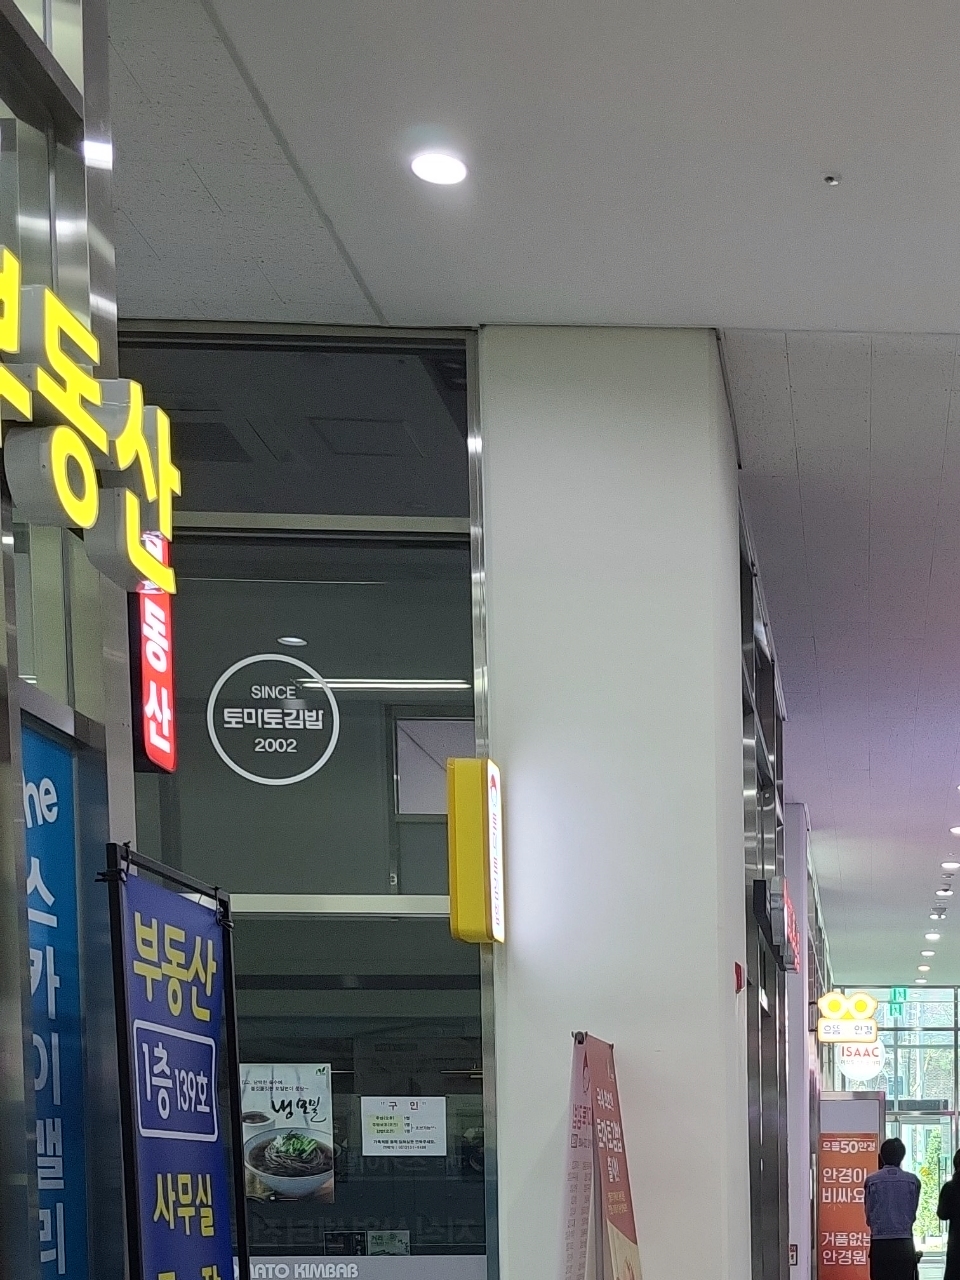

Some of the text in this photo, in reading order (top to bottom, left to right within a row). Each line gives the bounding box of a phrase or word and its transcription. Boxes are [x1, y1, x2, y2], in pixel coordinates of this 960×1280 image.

[251, 685, 297, 699] SINCE
[223, 707, 324, 730] 토마토김밥
[254, 738, 298, 753] 2002
[133, 911, 217, 1022] 부동산
[841, 1046, 880, 1057] ISAAC
[142, 1041, 211, 1120] 1층 139호
[822, 1168, 867, 1184] 안경이
[153, 1172, 215, 1238] 사무실
[821, 1232, 871, 1247] 거품없는
[294, 1263, 359, 1279] KIMBAB
